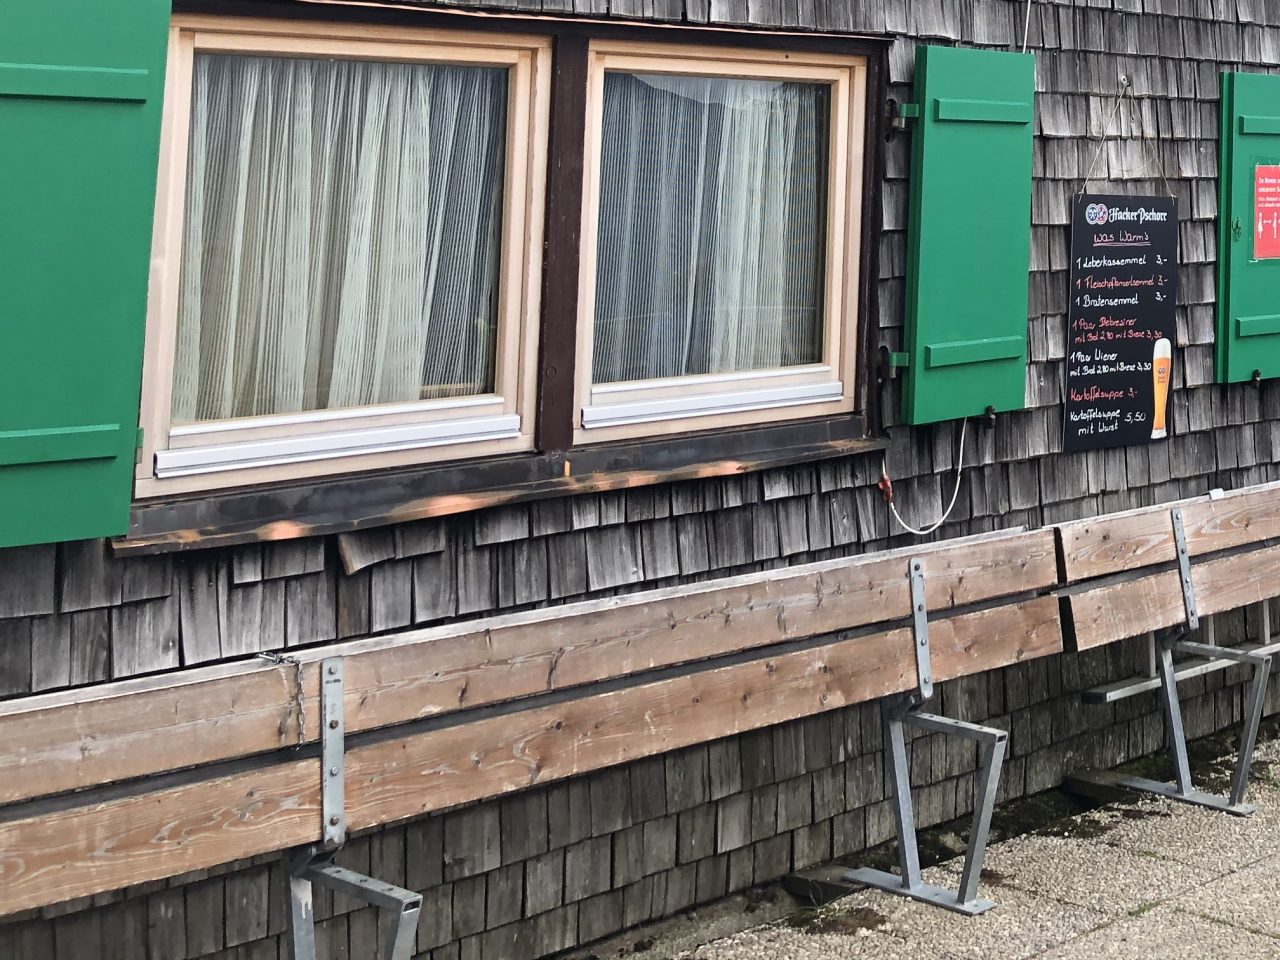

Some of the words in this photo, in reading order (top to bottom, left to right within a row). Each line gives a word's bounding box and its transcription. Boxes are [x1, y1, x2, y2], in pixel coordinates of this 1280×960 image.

[1076, 257, 1082, 270] 1
[1156, 254, 1168, 266] 3,-
[1076, 278, 1081, 290] 1
[1075, 296, 1081, 306] 1
[1082, 292, 1139, 308] Bratensemmel
[1155, 291, 1167, 302] 3,-
[1072, 320, 1078, 331] 1
[1079, 318, 1096, 331] Paar
[1146, 329, 1163, 341] 3,30
[1070, 351, 1076, 363] 1
[1076, 351, 1092, 362] Paar
[1094, 348, 1118, 361] Wiener
[1136, 361, 1152, 372] 3,30
[1070, 385, 1124, 402] Kartoffelsuppe
[1070, 407, 1121, 422] Kartoffelsuppe
[1124, 411, 1147, 425] 5,50
[1078, 422, 1095, 436] mit
[1098, 419, 1119, 433] Wurst
